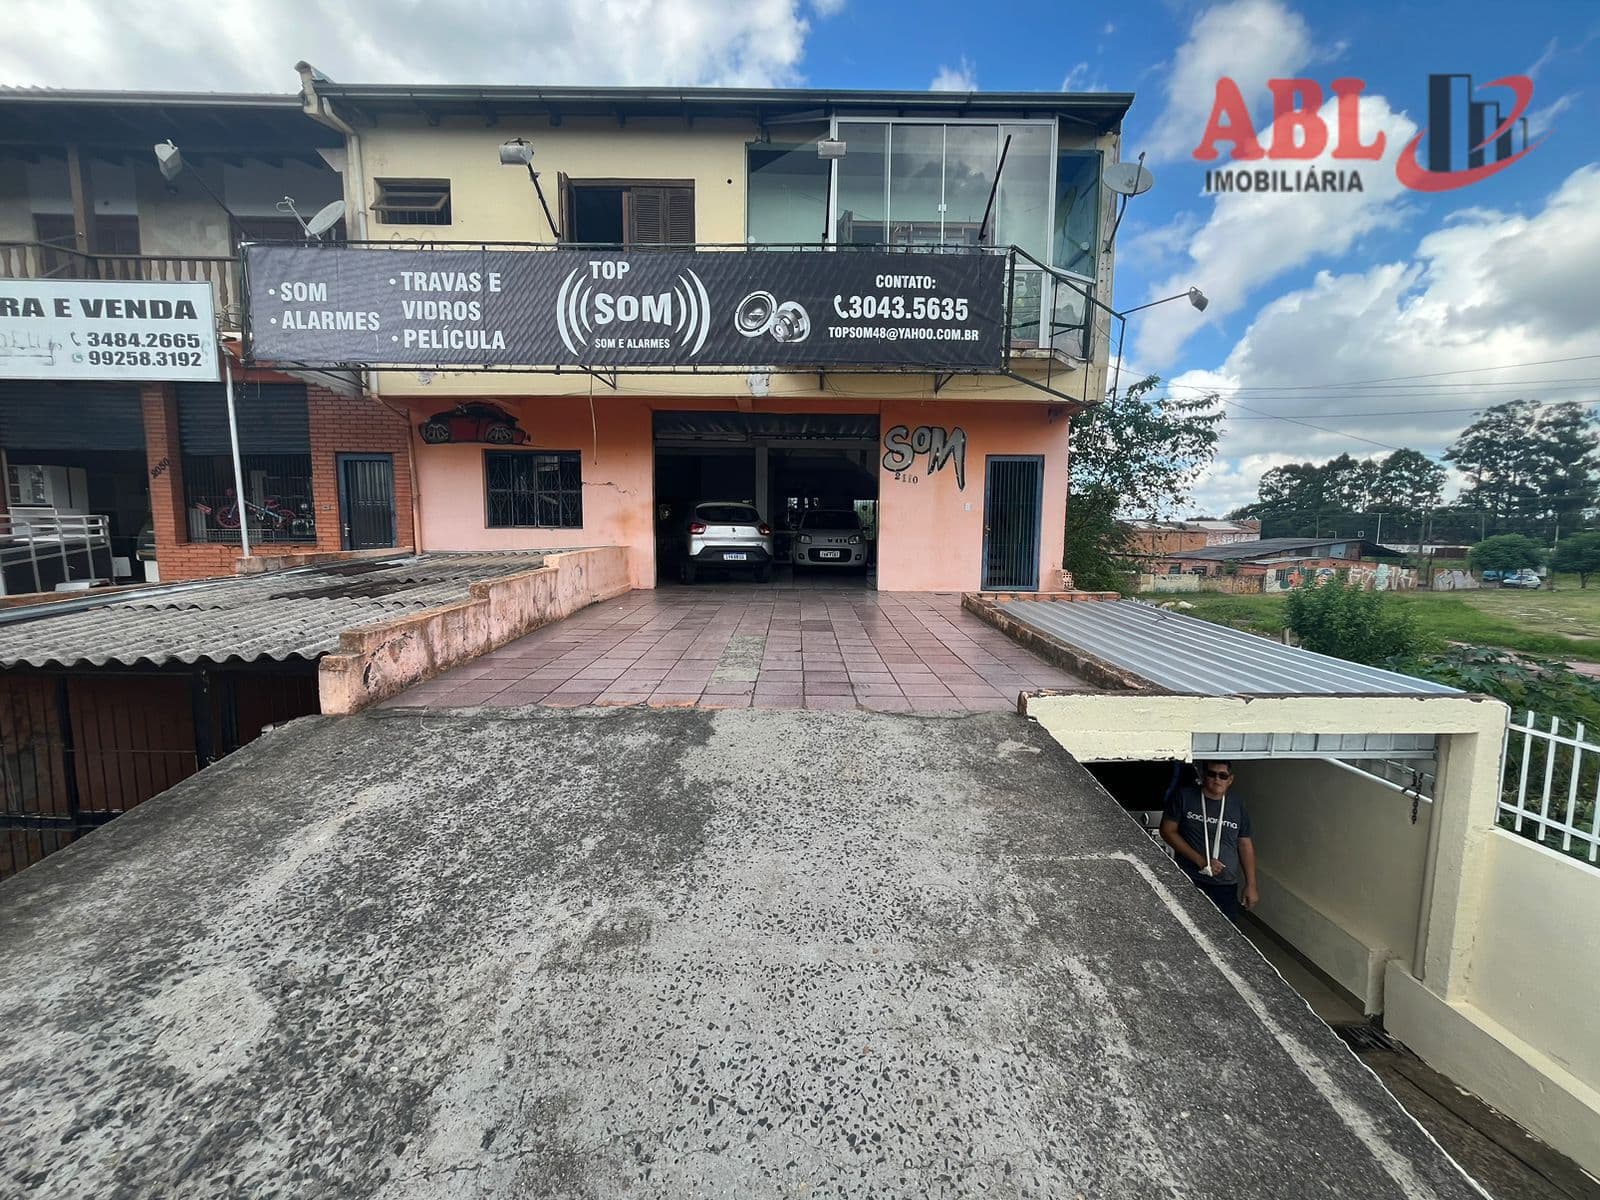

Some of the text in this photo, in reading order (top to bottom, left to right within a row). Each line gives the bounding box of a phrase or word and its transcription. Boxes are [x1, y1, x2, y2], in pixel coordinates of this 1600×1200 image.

[589, 261, 630, 280] TOP
[280, 282, 328, 302] SOM
[400, 272, 502, 293] TRAVAS E
[875, 274, 937, 290] CONTATO:
[54, 298, 72, 318] E
[79, 299, 198, 320] VENDA
[401, 300, 481, 321] VIDROS
[594, 292, 672, 326] SOM
[849, 295, 969, 321] 3043.5635
[281, 311, 381, 331] ALARMES
[87, 332, 200, 349] 3484.2665
[404, 326, 506, 350] PELÍCULA
[594, 338, 670, 349] SOM E ALARMES
[828, 326, 979, 341] TOPSOM48@YAHOO.COM.BR
[88, 351, 202, 367] 99258.3192
